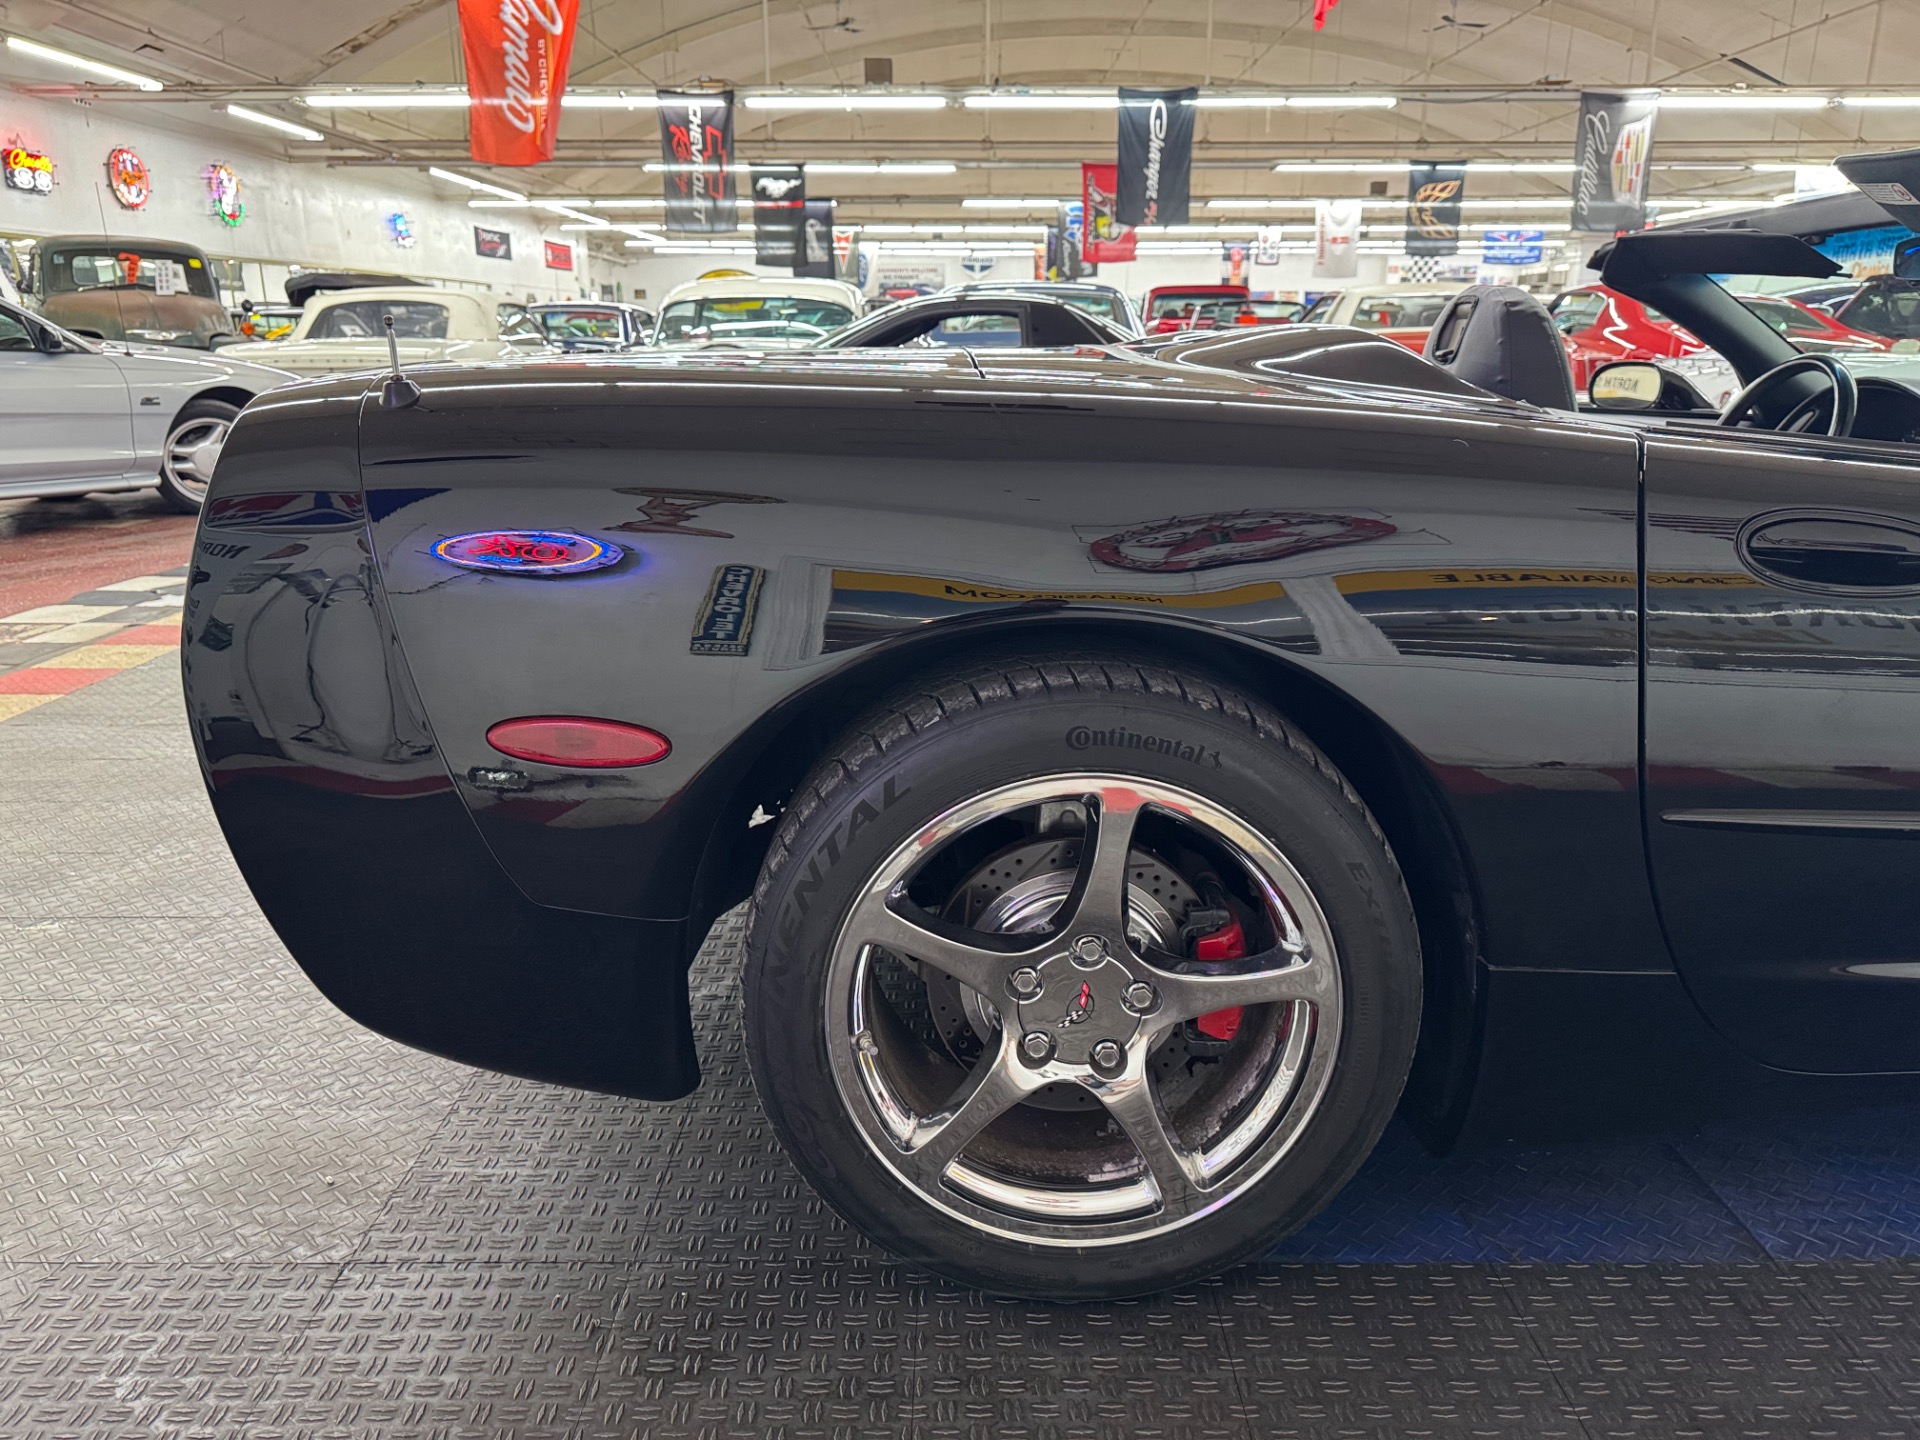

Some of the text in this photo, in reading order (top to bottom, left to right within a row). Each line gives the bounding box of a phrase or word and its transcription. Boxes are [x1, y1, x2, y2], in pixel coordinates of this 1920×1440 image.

[537, 38, 549, 131] BY CHEVOLE
[687, 105, 706, 224] CHEVOLET
[1143, 98, 1168, 200] Charger
[1577, 110, 1610, 216] Cadillac
[1065, 725, 1206, 767] Continental
